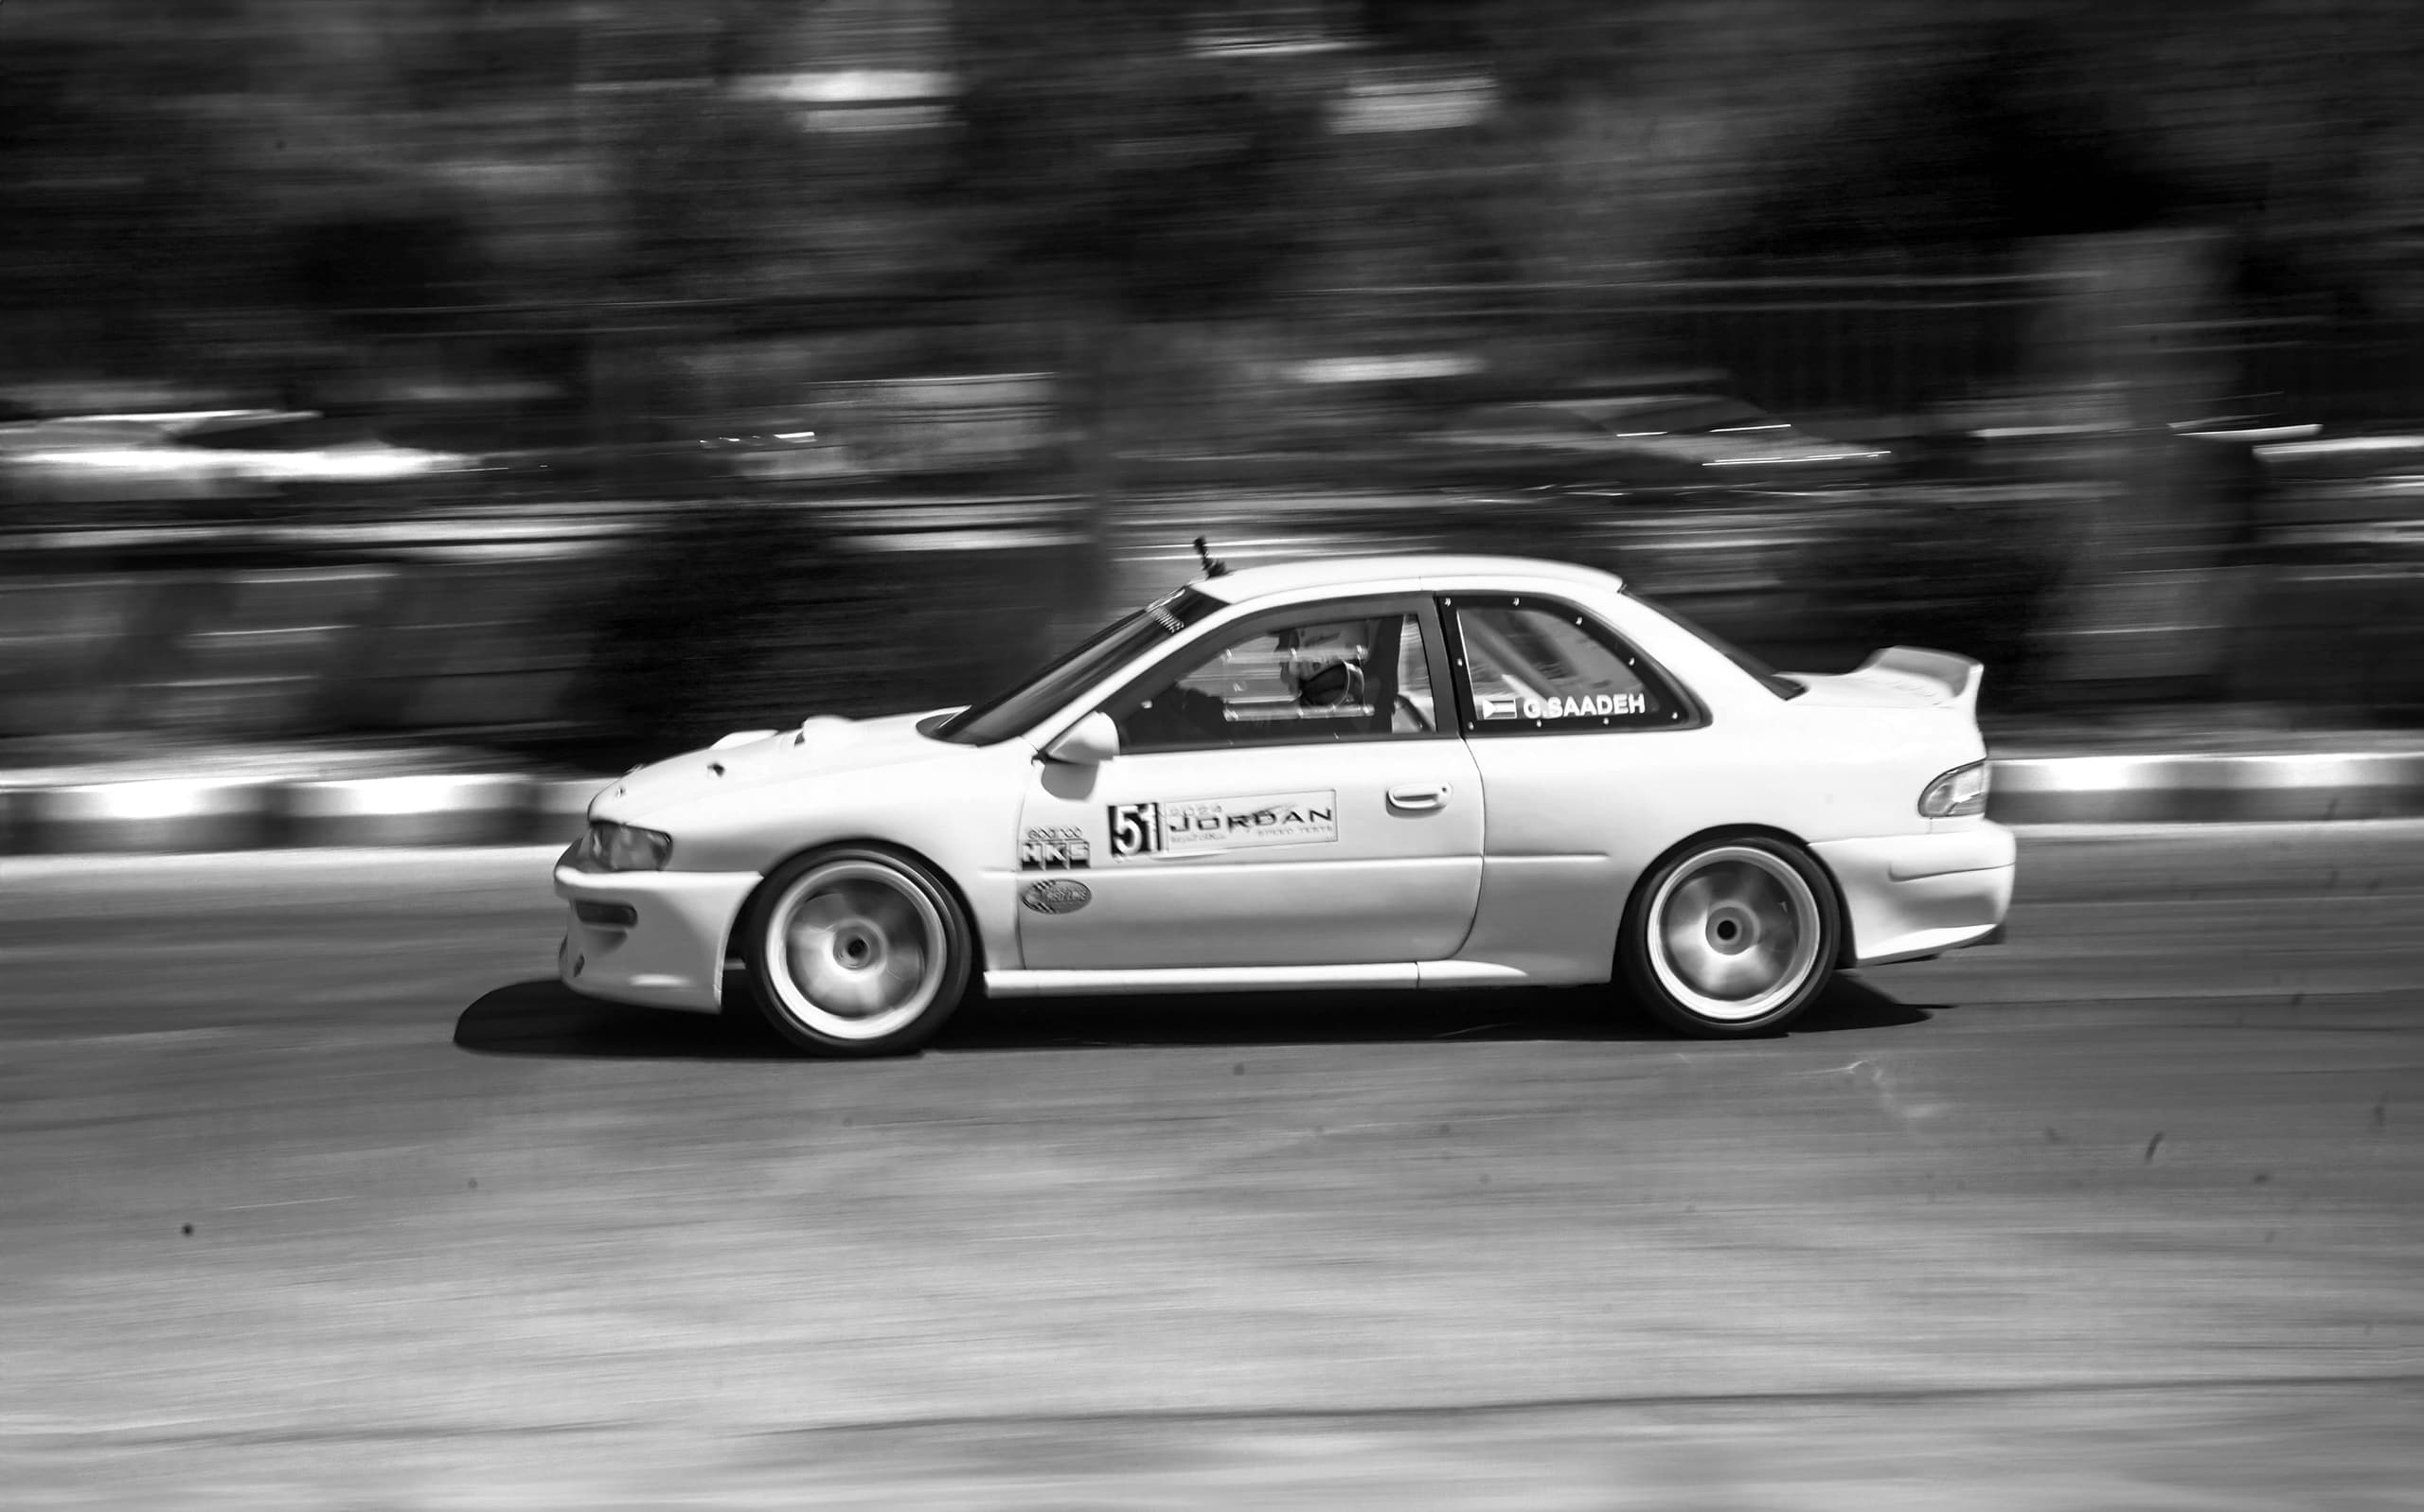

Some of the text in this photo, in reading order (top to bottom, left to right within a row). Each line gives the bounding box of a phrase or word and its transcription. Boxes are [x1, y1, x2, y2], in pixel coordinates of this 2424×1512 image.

[1524, 693, 1646, 719] G.SAADEH
[1112, 805, 1158, 855] 51
[1169, 809, 1333, 833] JORDAN
